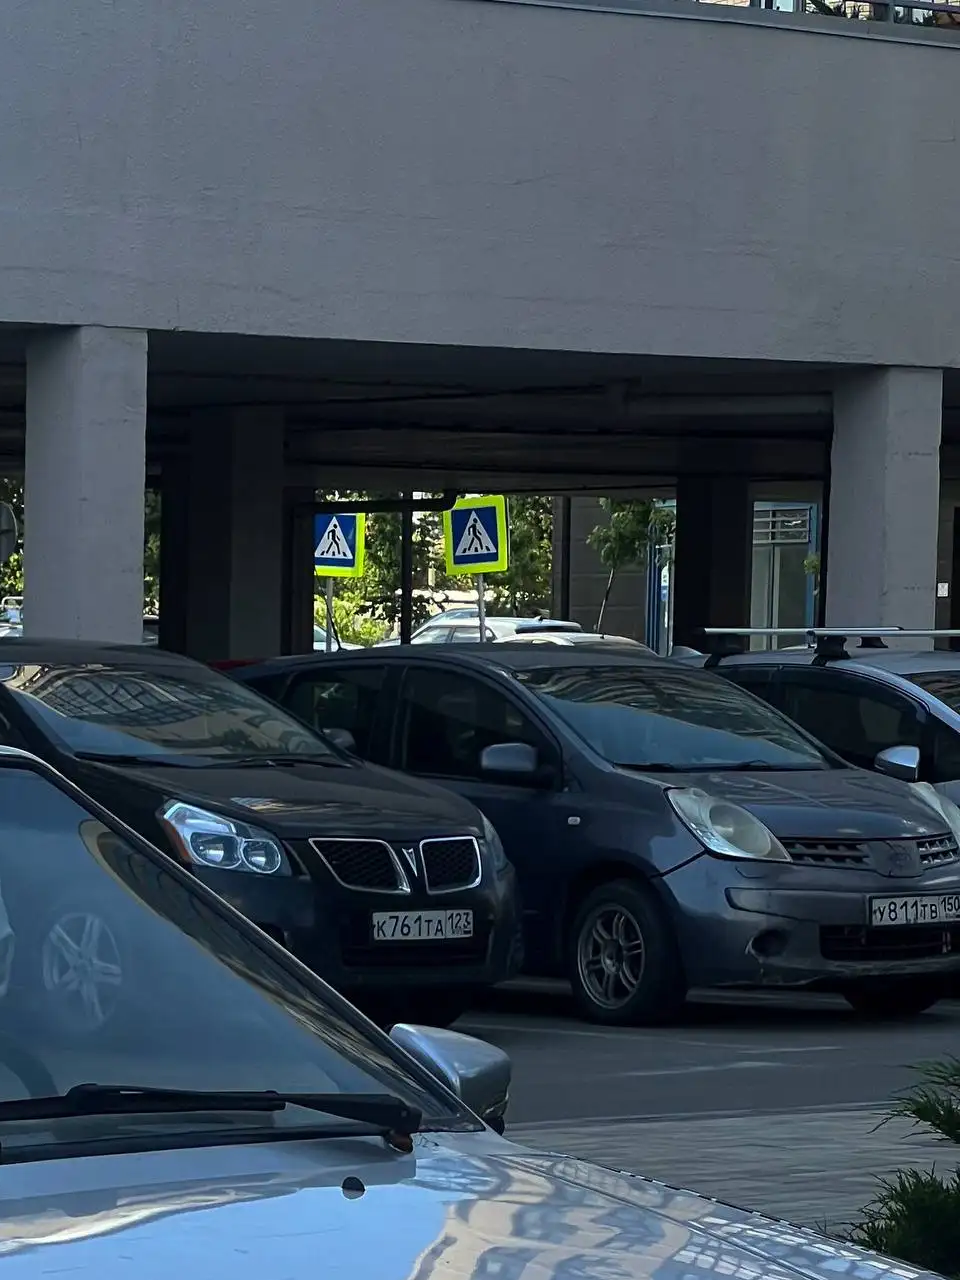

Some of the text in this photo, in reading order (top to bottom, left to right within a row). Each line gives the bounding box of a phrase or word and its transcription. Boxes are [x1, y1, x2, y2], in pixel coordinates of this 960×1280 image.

[877, 899, 938, 921] У811ТВ
[941, 896, 960, 913] 150
[376, 914, 444, 937] К761ТА
[448, 911, 471, 930] 123
